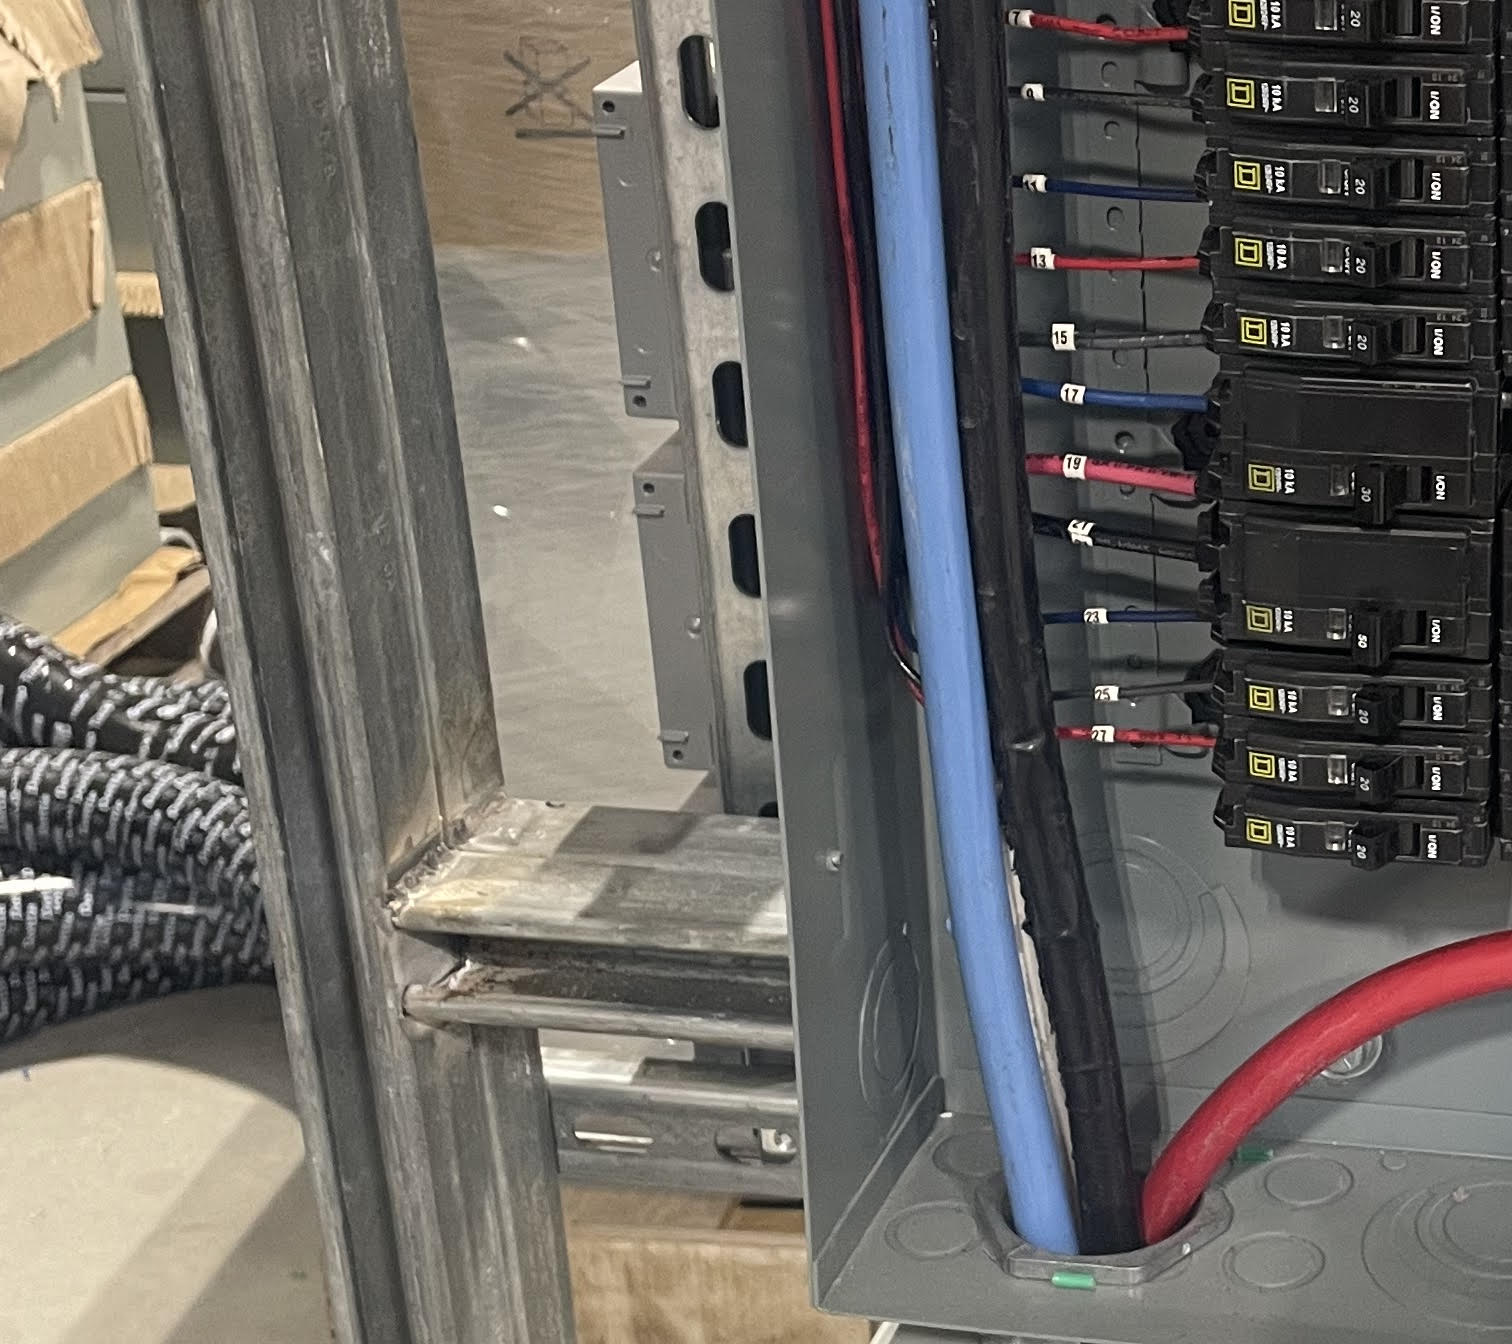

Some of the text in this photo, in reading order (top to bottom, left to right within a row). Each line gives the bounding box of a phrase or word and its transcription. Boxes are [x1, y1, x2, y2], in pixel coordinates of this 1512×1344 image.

[1351, 10, 1360, 27] 20
[1349, 97, 1359, 113] 20
[1355, 179, 1365, 194] 20
[1032, 253, 1047, 267] 13
[1356, 258, 1365, 273] 20
[1053, 330, 1068, 345] 15
[1358, 335, 1367, 350] 20
[1064, 388, 1079, 402] 17
[1066, 456, 1082, 470] 19
[1361, 487, 1371, 502] 30
[1084, 612, 1100, 623] 23
[1359, 710, 1368, 724] 20
[1360, 777, 1369, 791] 20
[1357, 845, 1366, 859] 20
